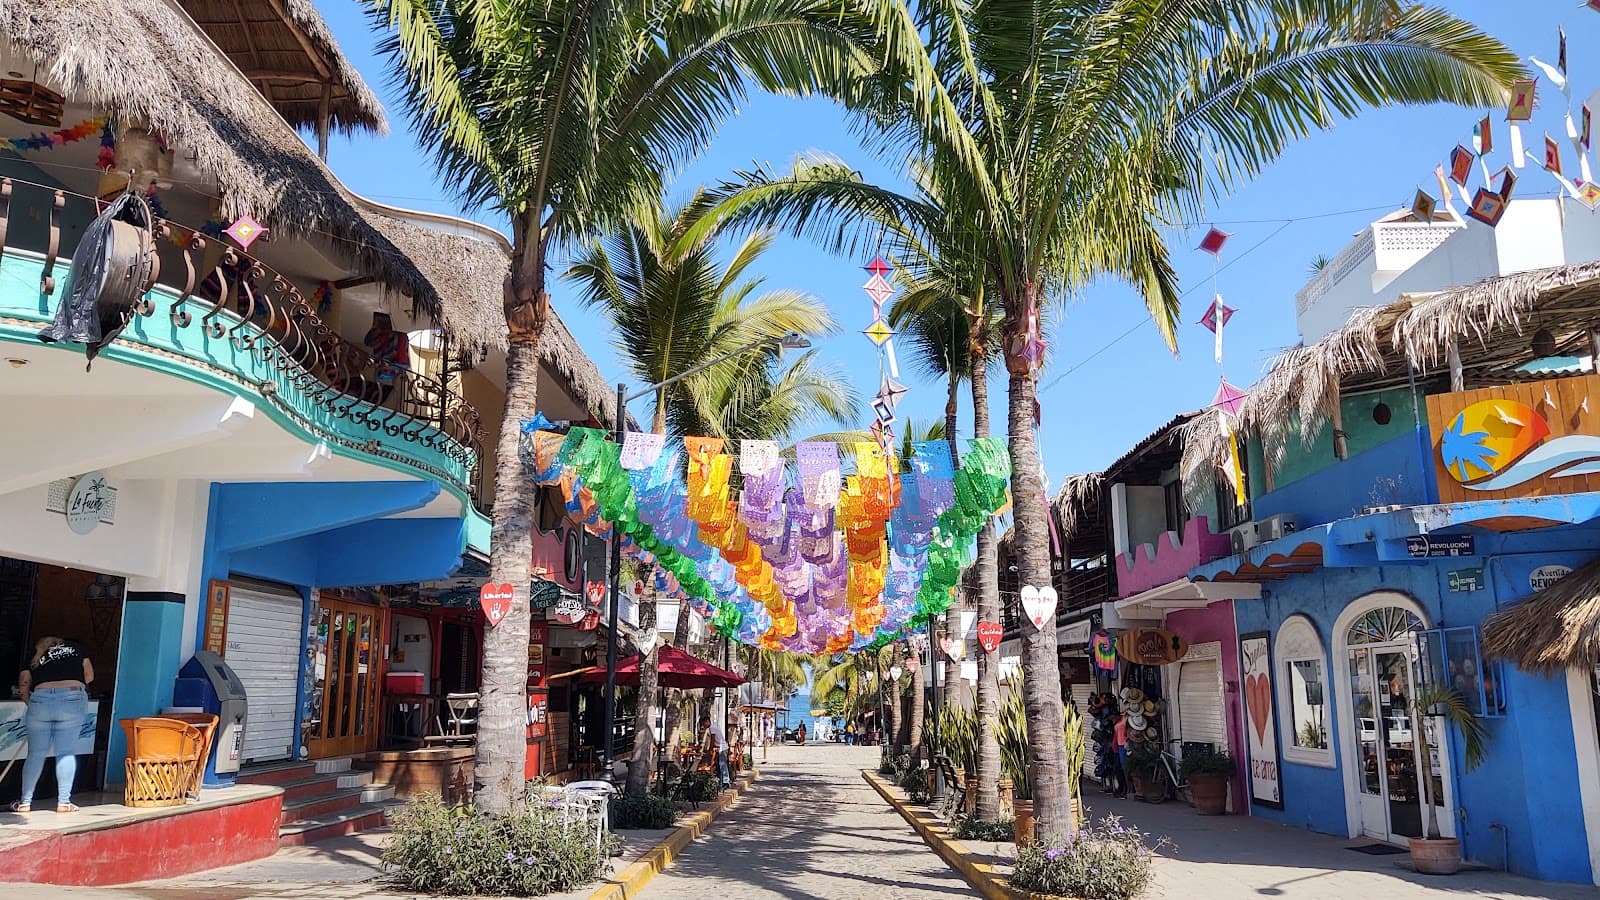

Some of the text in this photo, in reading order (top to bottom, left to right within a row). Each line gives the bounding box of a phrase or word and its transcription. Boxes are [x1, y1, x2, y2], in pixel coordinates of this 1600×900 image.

[72, 490, 103, 513] La Fuente
[1537, 569, 1570, 577] Avenida
[484, 592, 512, 600] Libertad
[980, 627, 1003, 635] Caridad
[1252, 757, 1277, 781] te ama
